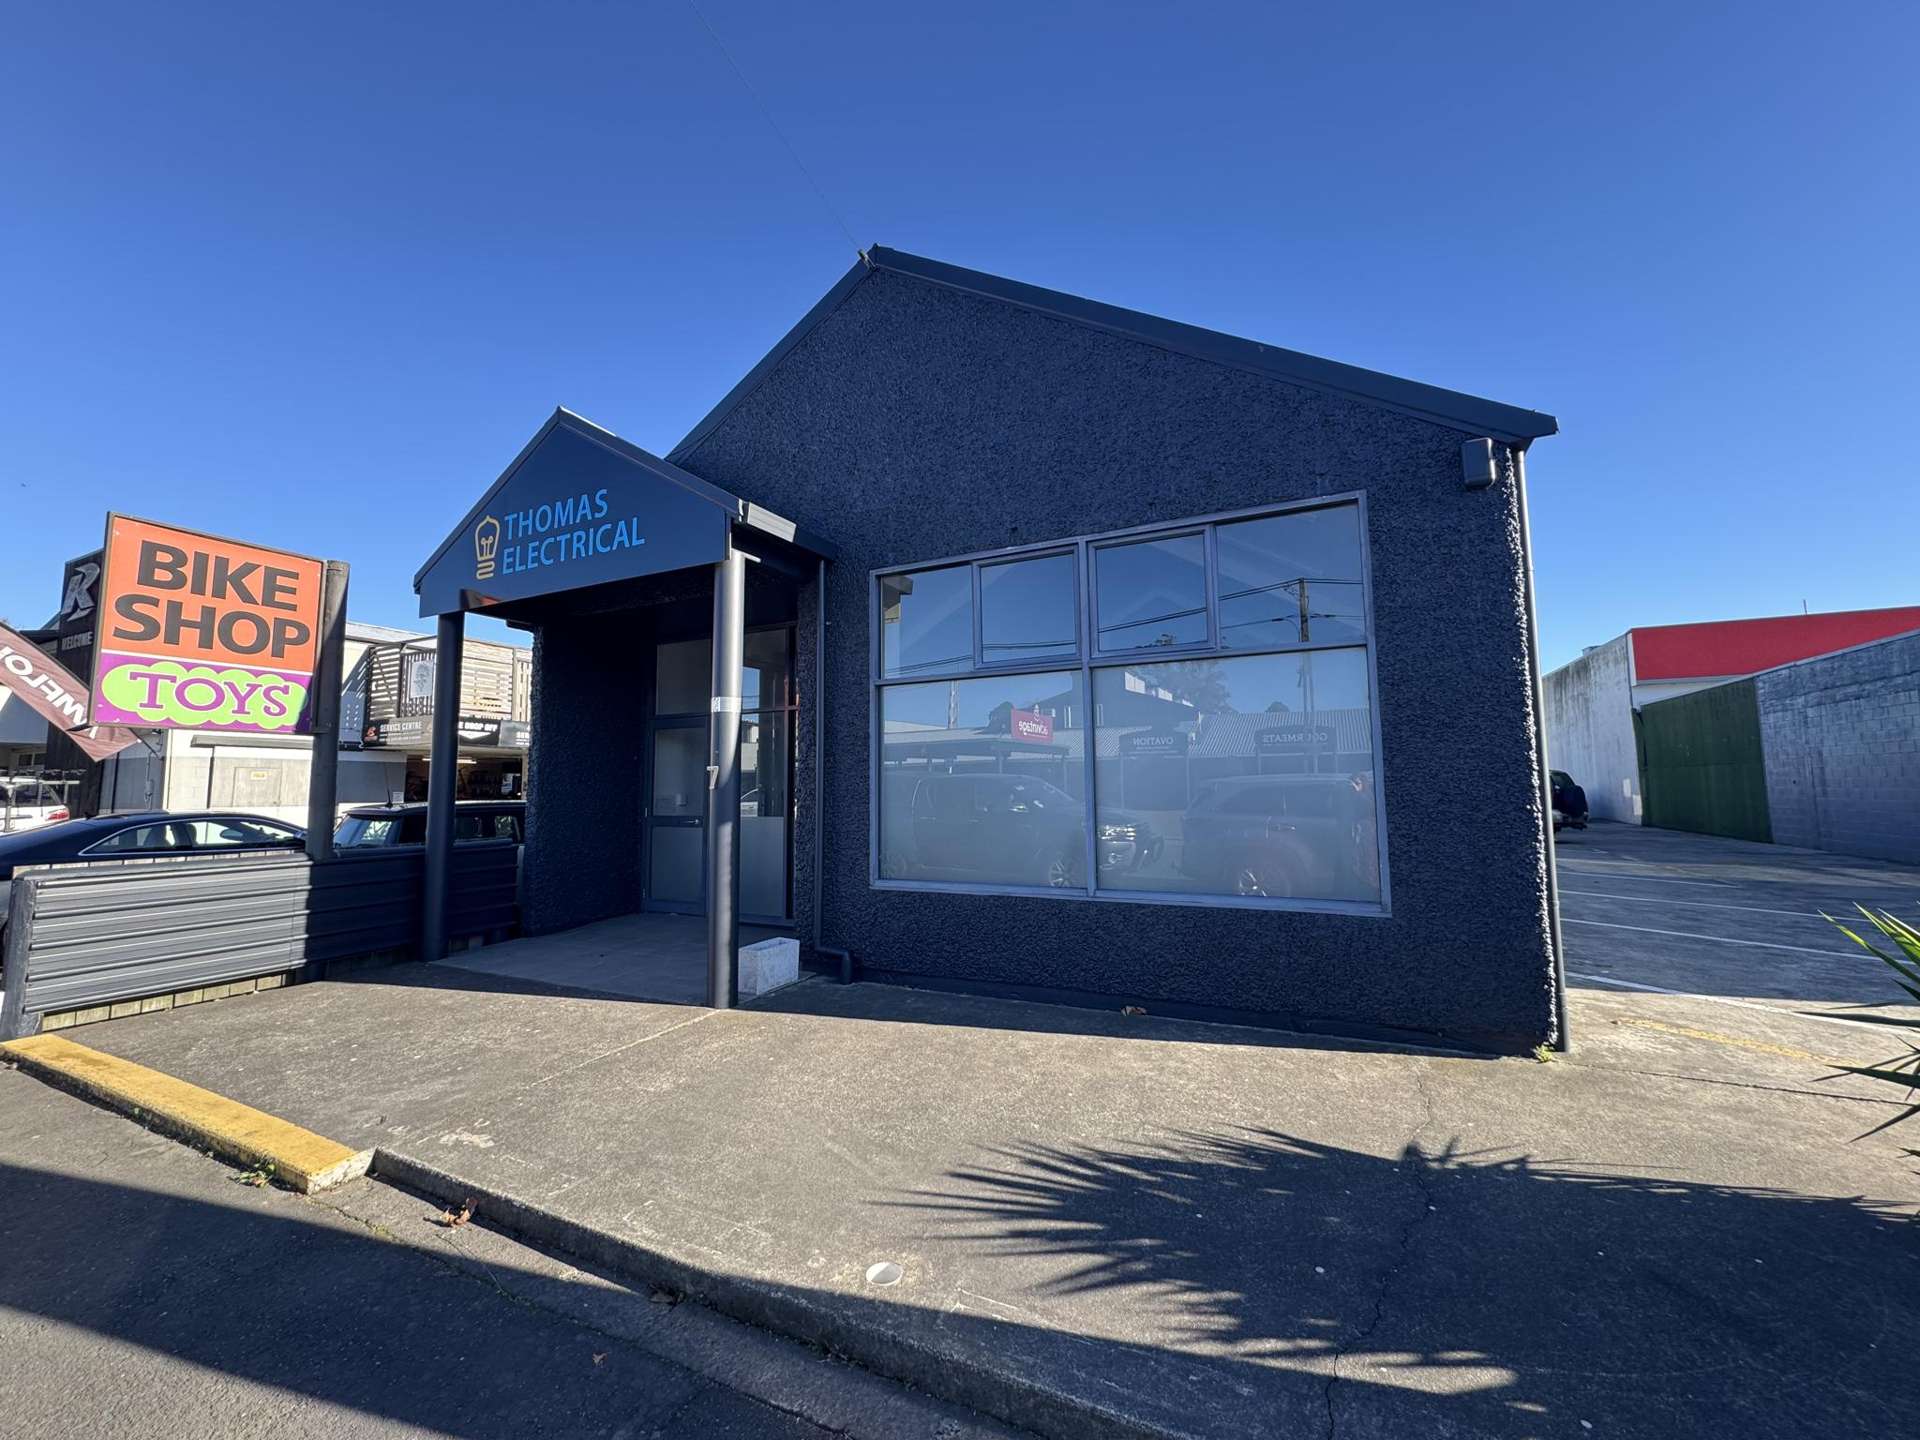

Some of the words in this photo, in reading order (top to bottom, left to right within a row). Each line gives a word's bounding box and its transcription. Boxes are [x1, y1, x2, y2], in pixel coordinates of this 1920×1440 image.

[504, 489, 608, 540] THOMAS
[502, 517, 645, 575] ELECTRICAL
[137, 540, 299, 612] BIKE
[112, 594, 310, 658] SHOP
[129, 671, 290, 716] TOYS
[380, 723, 401, 732] SERVICE
[402, 721, 422, 730] CENTRE
[706, 765, 719, 790] 7
